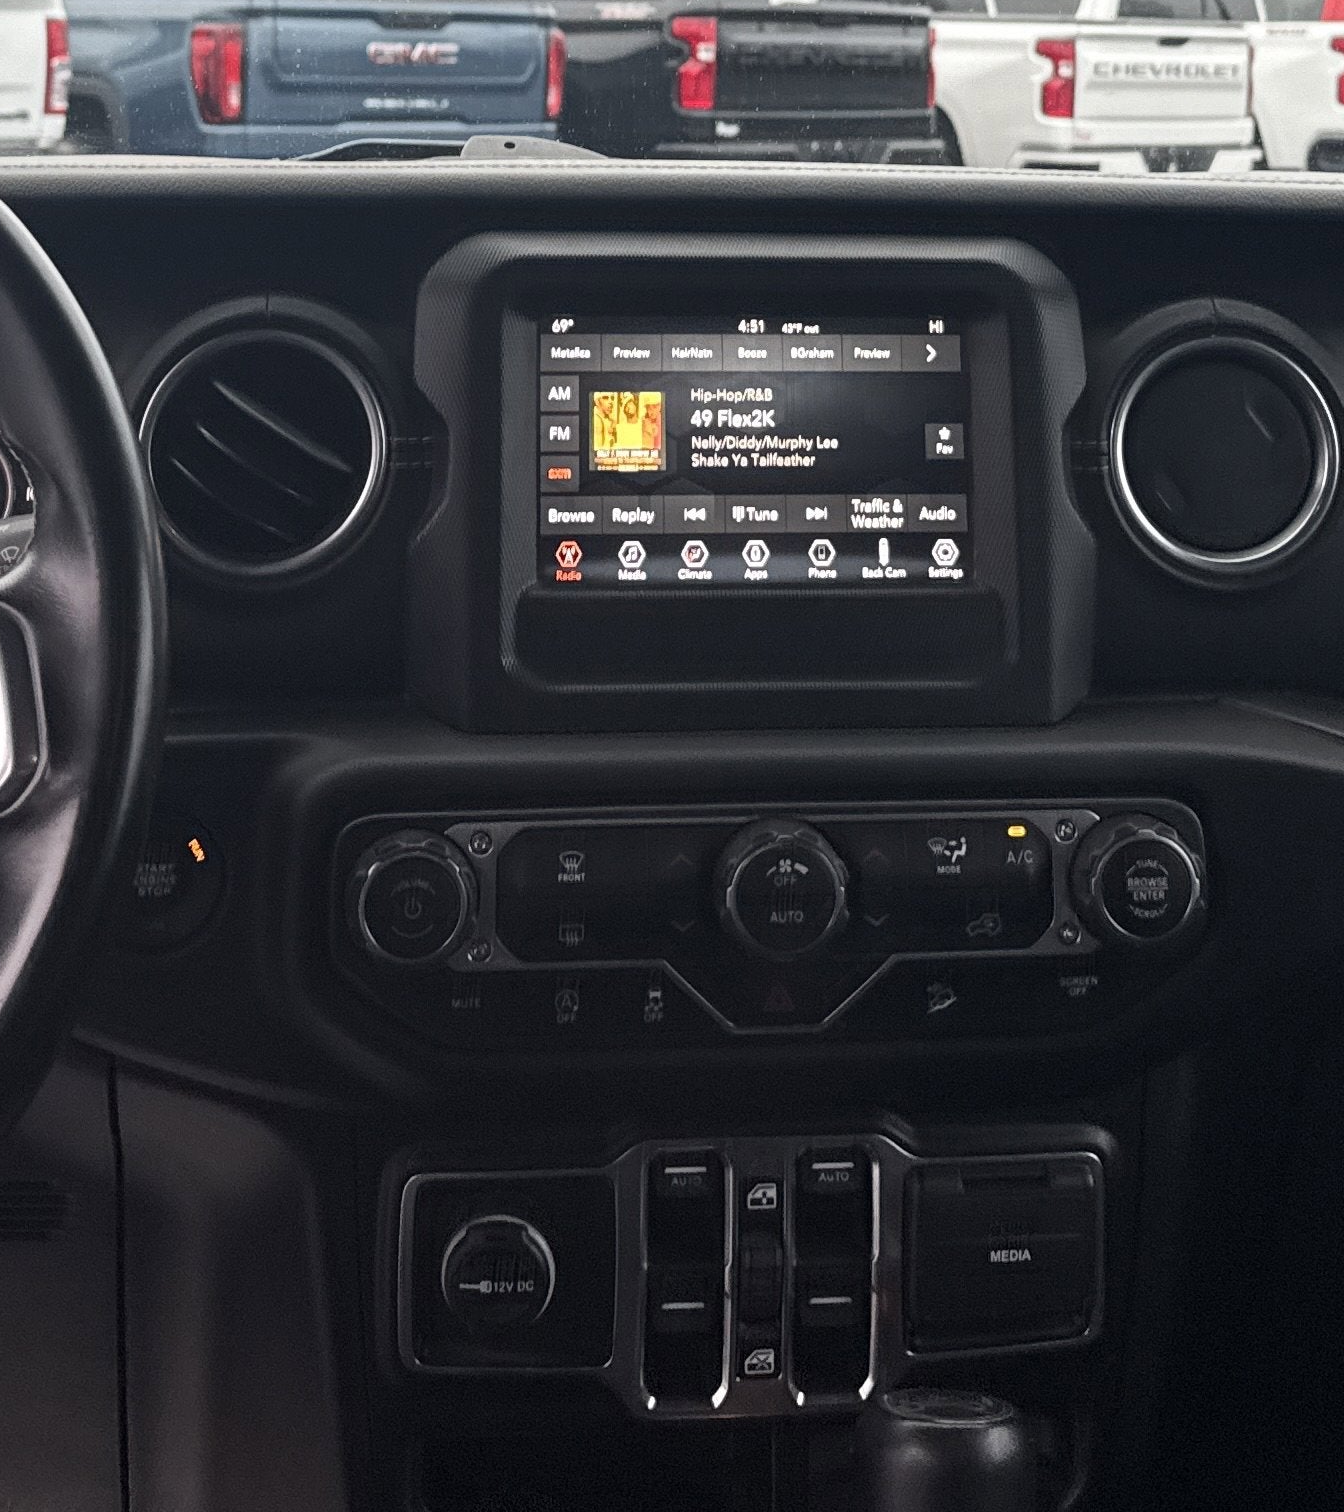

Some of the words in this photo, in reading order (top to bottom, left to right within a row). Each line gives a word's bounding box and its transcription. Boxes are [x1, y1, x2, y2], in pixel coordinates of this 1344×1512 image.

[366, 42, 459, 65] GMC
[1093, 61, 1240, 78] CHEVROLET
[738, 320, 765, 333] 4:51
[929, 320, 944, 333] HI
[613, 347, 650, 359] Preview
[854, 347, 890, 360] Preview
[548, 387, 571, 401] AM
[690, 388, 773, 405] Hip-Hop/R&B
[690, 410, 712, 427] 49
[717, 410, 775, 428] Flex2K
[549, 427, 570, 441] FM
[691, 435, 810, 452] Nelly/Diddy/Murphy
[815, 436, 839, 449] Lee
[936, 443, 954, 455] Fav
[691, 454, 728, 468] Shake
[732, 454, 748, 467] Ya
[751, 453, 816, 468] Tailfeather
[851, 499, 889, 514] Traffic
[892, 499, 903, 513] &
[548, 508, 595, 523] Browse
[612, 507, 654, 525] Replay
[746, 507, 778, 521] Tune
[919, 506, 956, 521] Audio
[851, 514, 904, 529] Weather
[555, 569, 582, 581] Radio
[618, 568, 646, 581] Media
[678, 568, 712, 580] Climate
[744, 568, 768, 581] Apps
[808, 567, 837, 579] Phone
[862, 567, 881, 579] Back
[882, 567, 906, 579] Cam
[928, 567, 964, 581] Settings
[188, 838, 205, 863] RUN
[1006, 849, 1034, 864] A/C
[936, 865, 961, 874] MODE
[558, 873, 586, 883] FRONT
[773, 875, 798, 887] OFF
[1127, 877, 1169, 887] BROWSE
[1133, 890, 1166, 901] ENTER
[770, 911, 804, 923] AUTO
[1060, 976, 1098, 987] SCREEN
[451, 998, 481, 1009] MUTE
[556, 1013, 576, 1024] OFF
[671, 1175, 702, 1187] AUTO
[818, 1170, 850, 1182] AUTO
[989, 1248, 1032, 1263] MEDIA
[491, 1280, 514, 1294] 12V
[517, 1279, 535, 1293] DC
